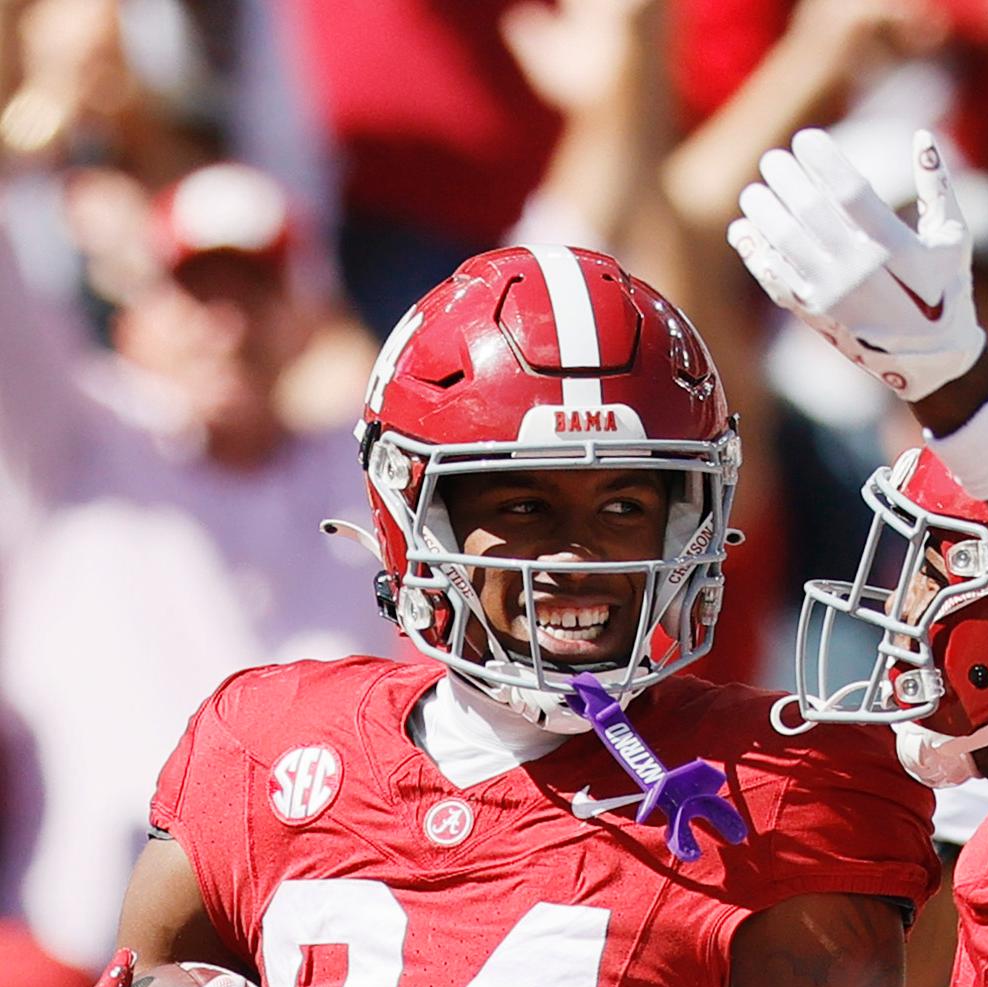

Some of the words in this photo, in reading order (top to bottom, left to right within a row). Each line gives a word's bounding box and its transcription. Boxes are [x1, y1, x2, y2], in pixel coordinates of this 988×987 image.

[554, 410, 618, 432] BAMA
[446, 566, 475, 598] TIDE
[604, 722, 667, 785] NXTRND
[270, 746, 338, 818] SEC
